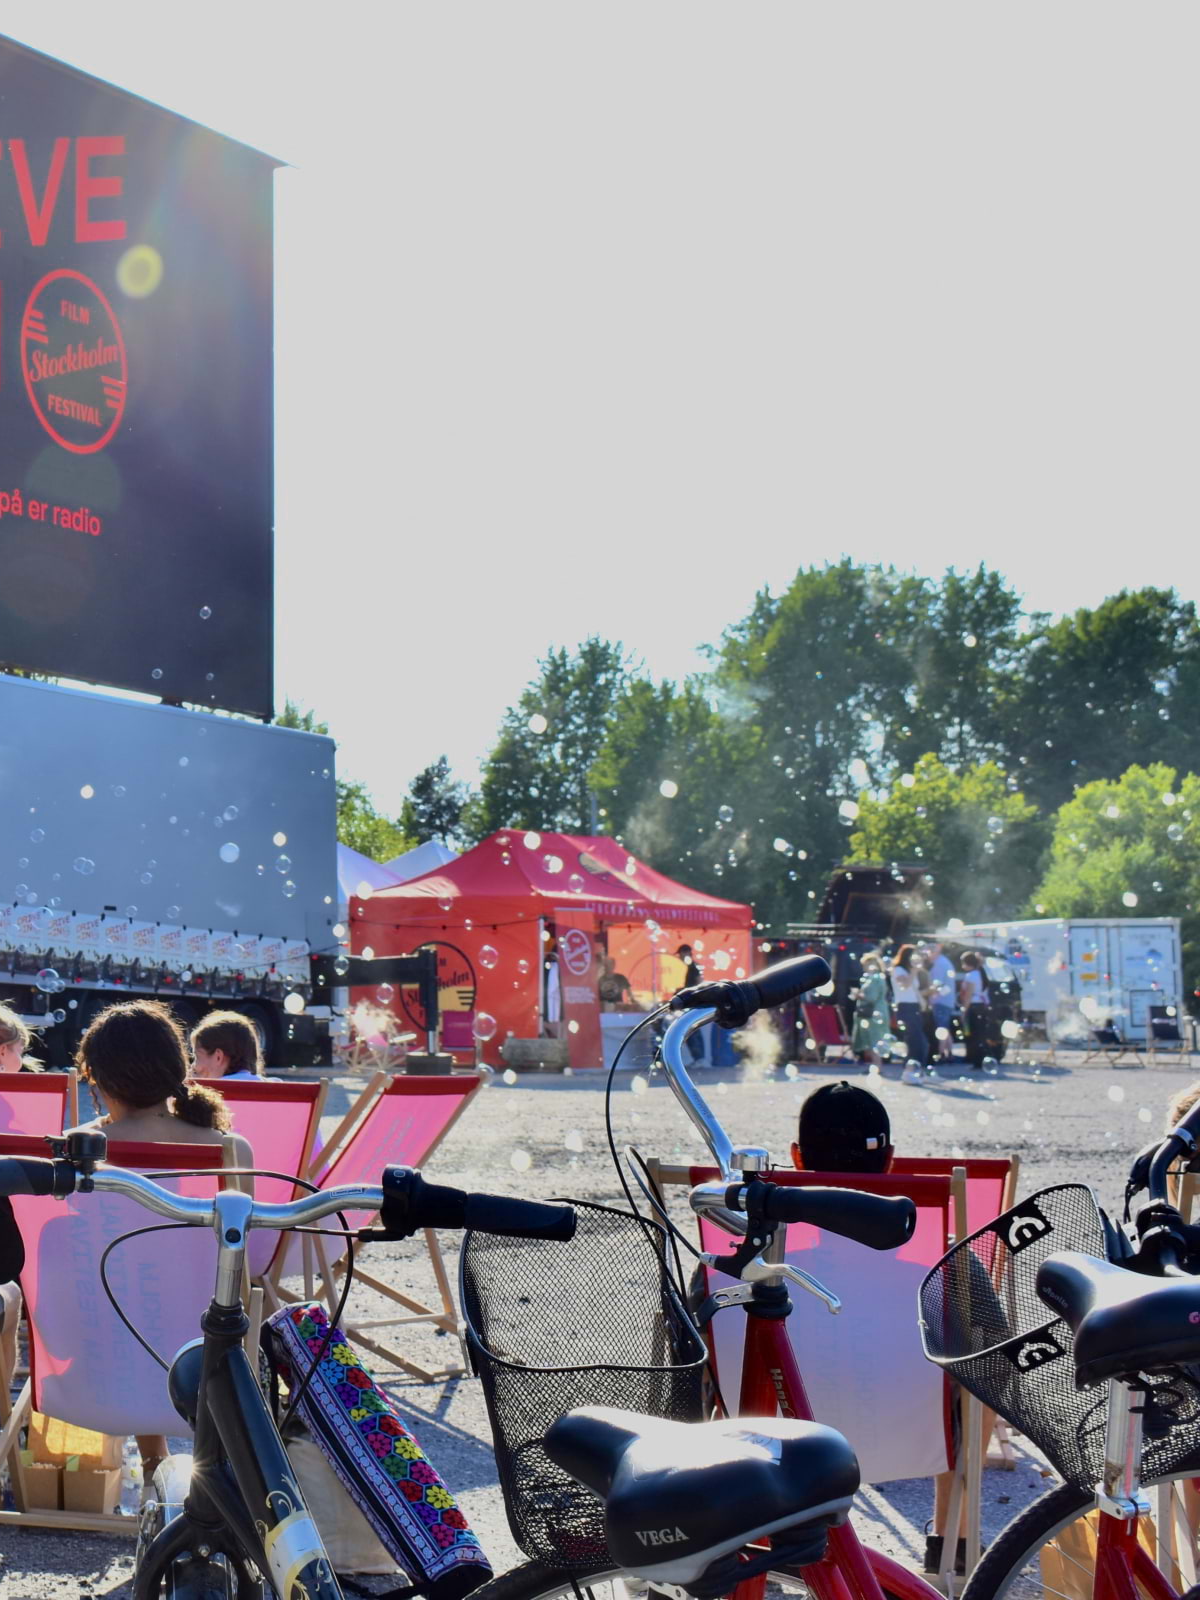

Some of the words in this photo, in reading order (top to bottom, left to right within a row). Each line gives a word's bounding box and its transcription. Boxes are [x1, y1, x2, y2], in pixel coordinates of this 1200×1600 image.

[61, 299, 90, 325] FILM
[30, 336, 119, 382] Stockholm
[47, 393, 102, 427] FESTIVAL
[28, 500, 48, 521] er
[53, 506, 101, 536] radio
[634, 1525, 690, 1547] VEGA
